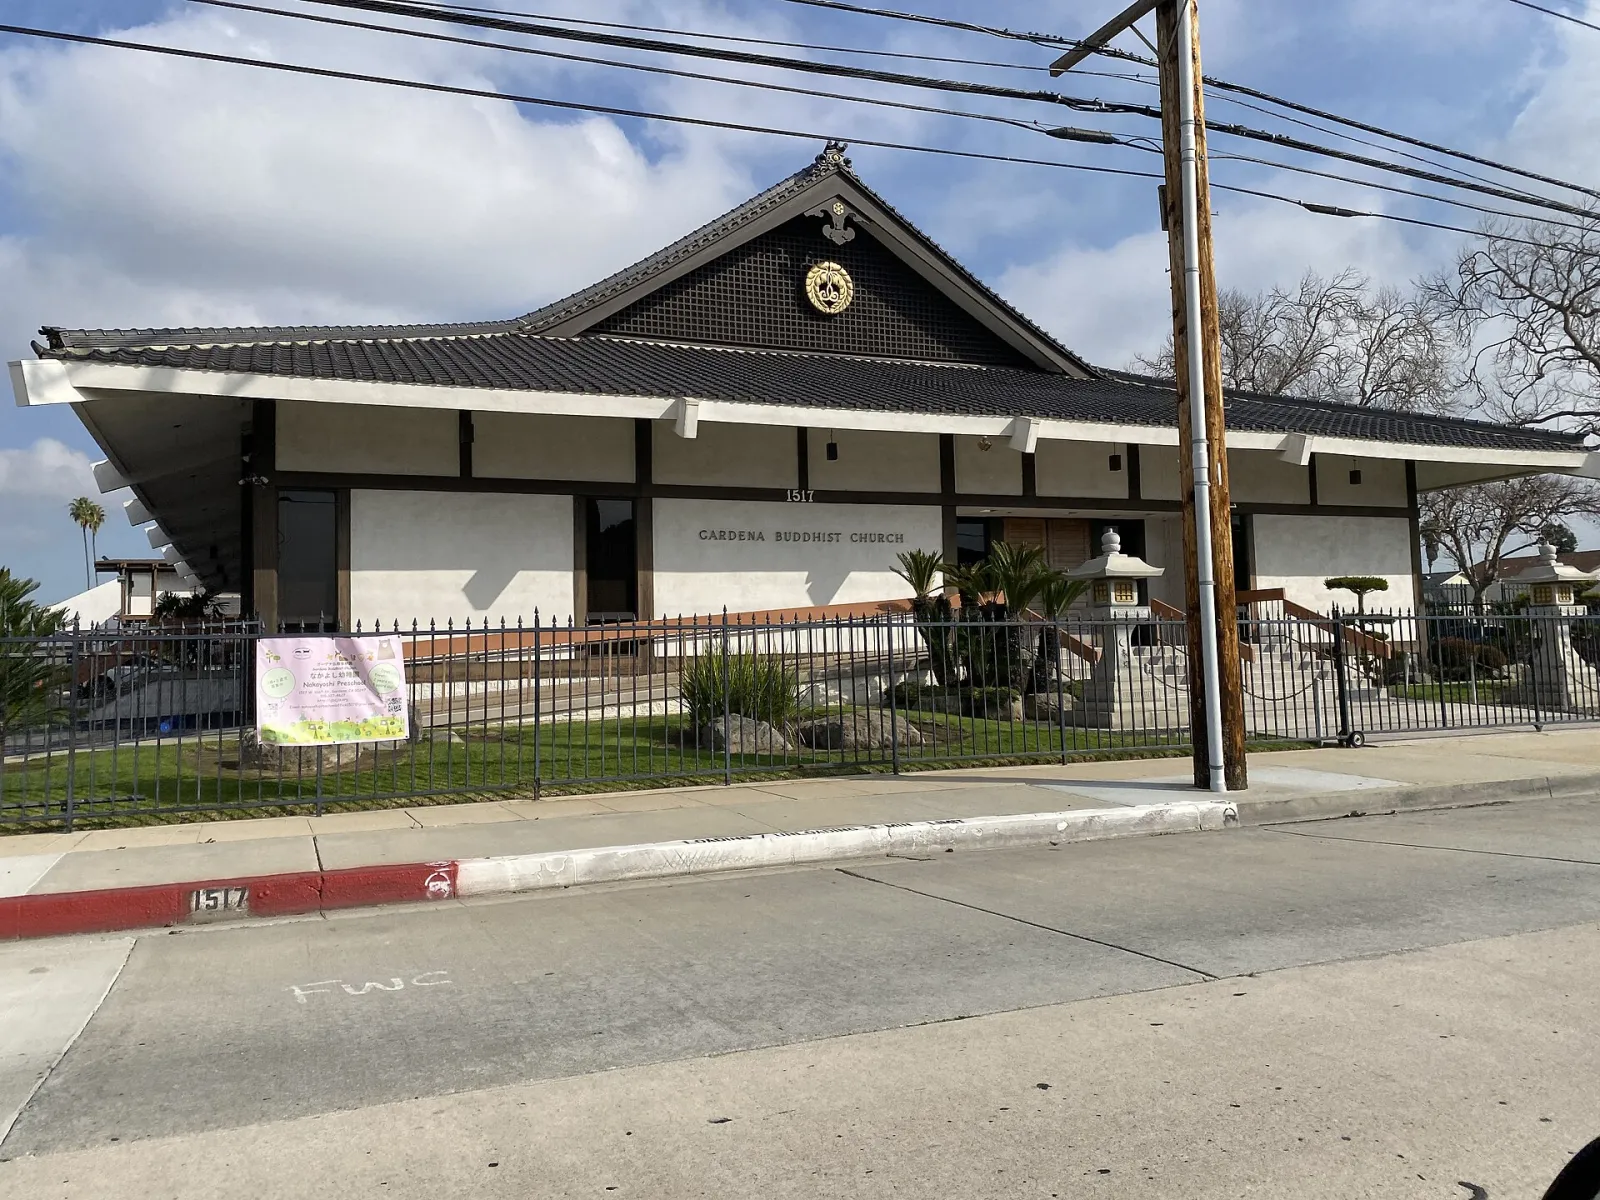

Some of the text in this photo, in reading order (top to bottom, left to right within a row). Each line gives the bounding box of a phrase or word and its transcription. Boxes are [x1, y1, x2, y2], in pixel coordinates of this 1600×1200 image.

[786, 489, 814, 502] 1517
[699, 529, 904, 543] GARDENA BUDDHIST CHURCH
[194, 887, 247, 911] 1517
